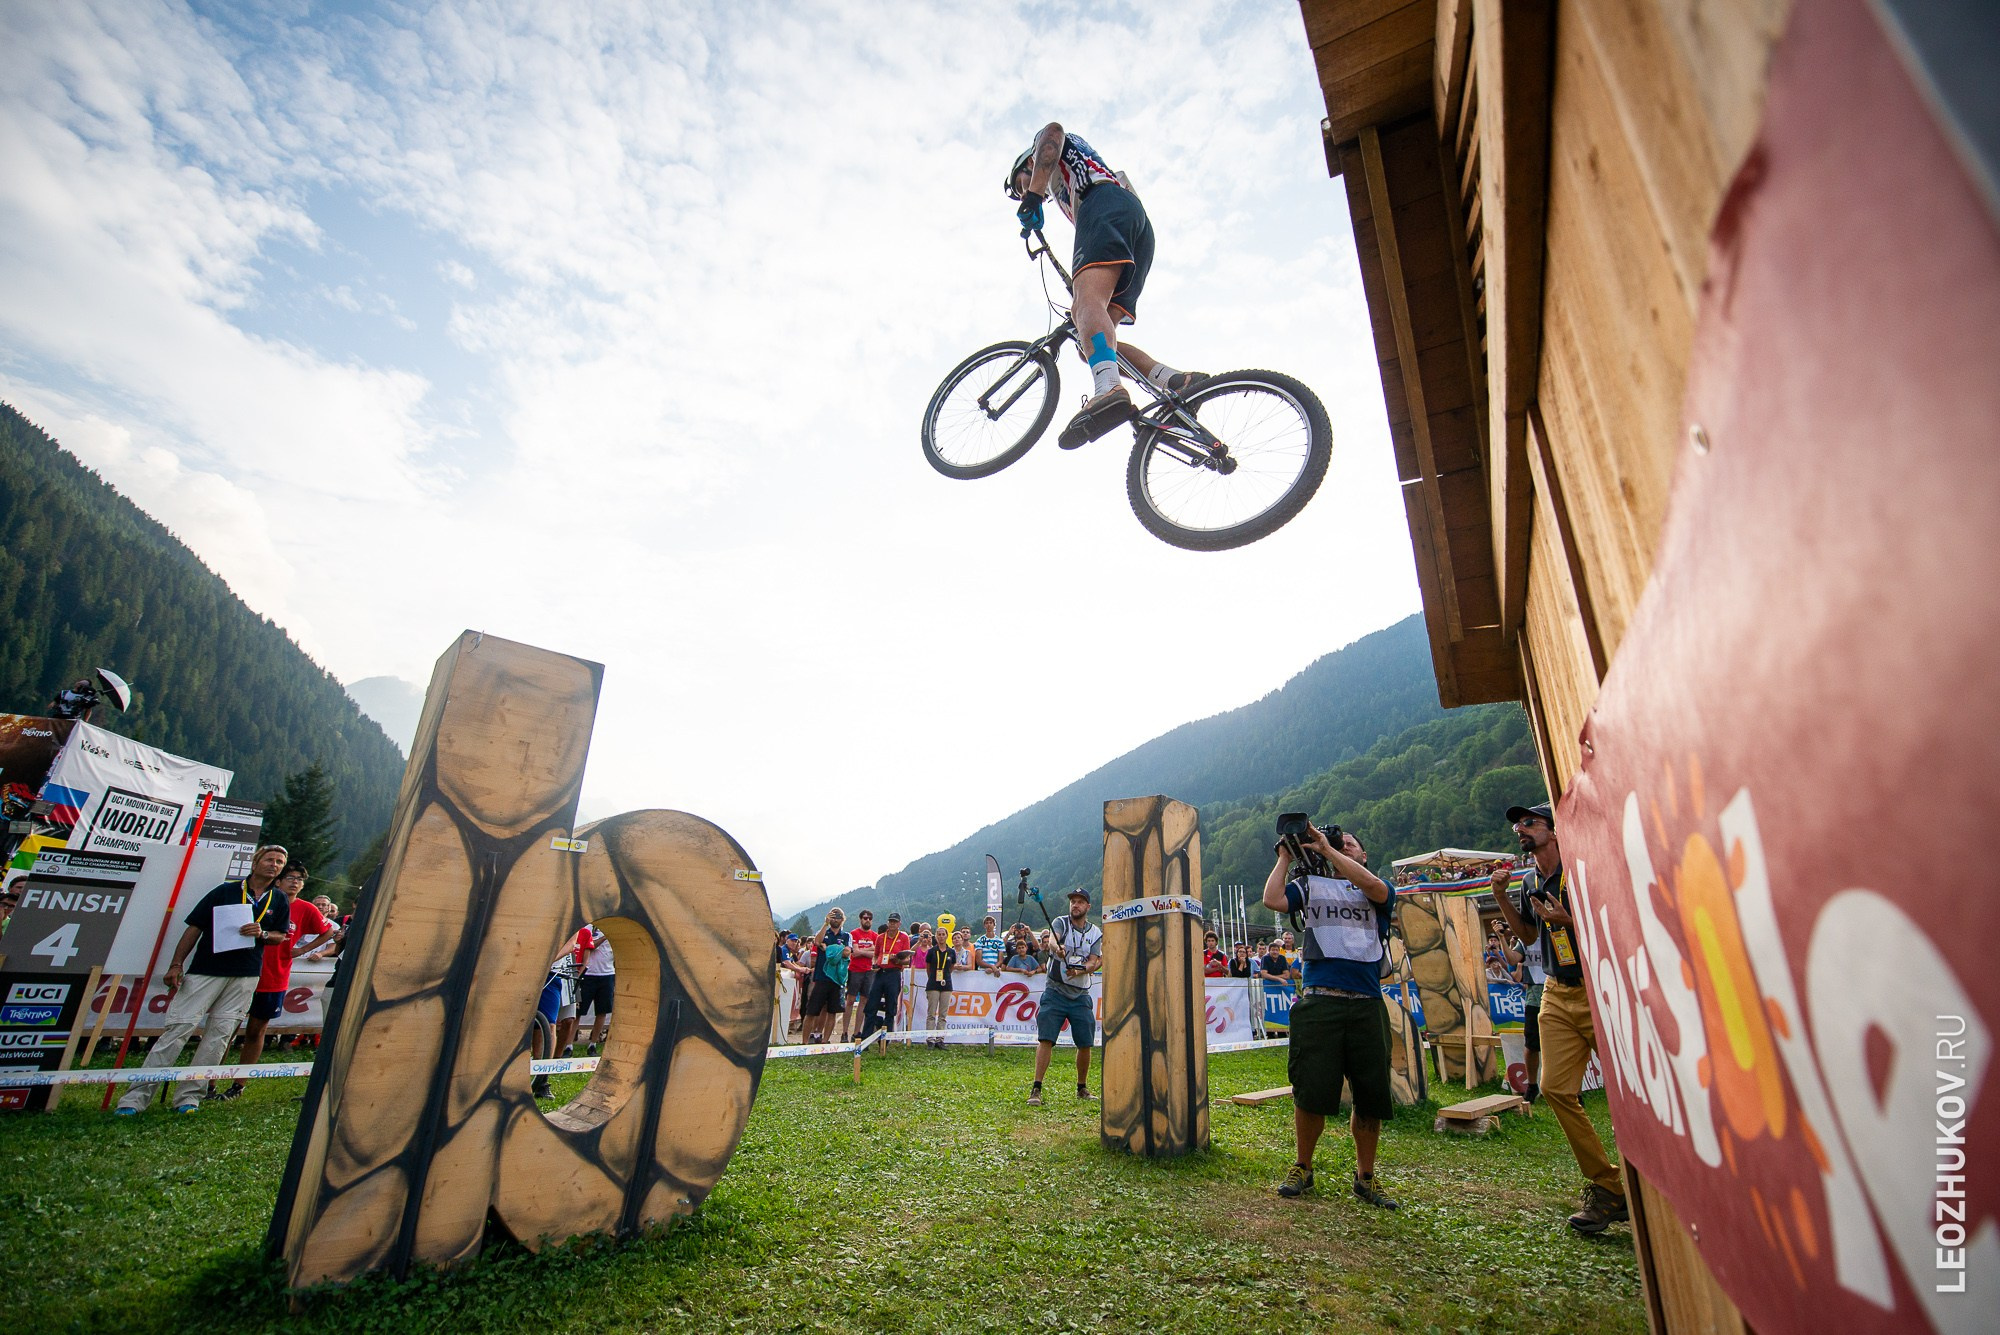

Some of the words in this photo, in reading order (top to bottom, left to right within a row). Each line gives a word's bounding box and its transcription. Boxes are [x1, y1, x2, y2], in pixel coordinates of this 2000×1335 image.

[21, 727, 53, 738] TRENTINO
[111, 794, 125, 805] UCI
[124, 798, 161, 814] MOUNTAIN
[159, 807, 175, 817] BIKE
[100, 807, 169, 841] WORLD
[93, 835, 142, 852] CHAMPIONS
[213, 842, 237, 850] CARTHY
[42, 853, 68, 864] UCI
[88, 861, 129, 870] CHAMPIONSHIPS
[21, 888, 125, 914] FINISH
[1110, 904, 1144, 920] TRENTINO
[1326, 905, 1371, 922] HOST
[30, 922, 81, 967] 4
[24, 987, 62, 1000] UCI
[995, 981, 1040, 1023] Po
[9, 1007, 53, 1020] TRENTINO
[1, 1034, 39, 1046] UCI
[0, 1050, 45, 1059] alsWorlds
